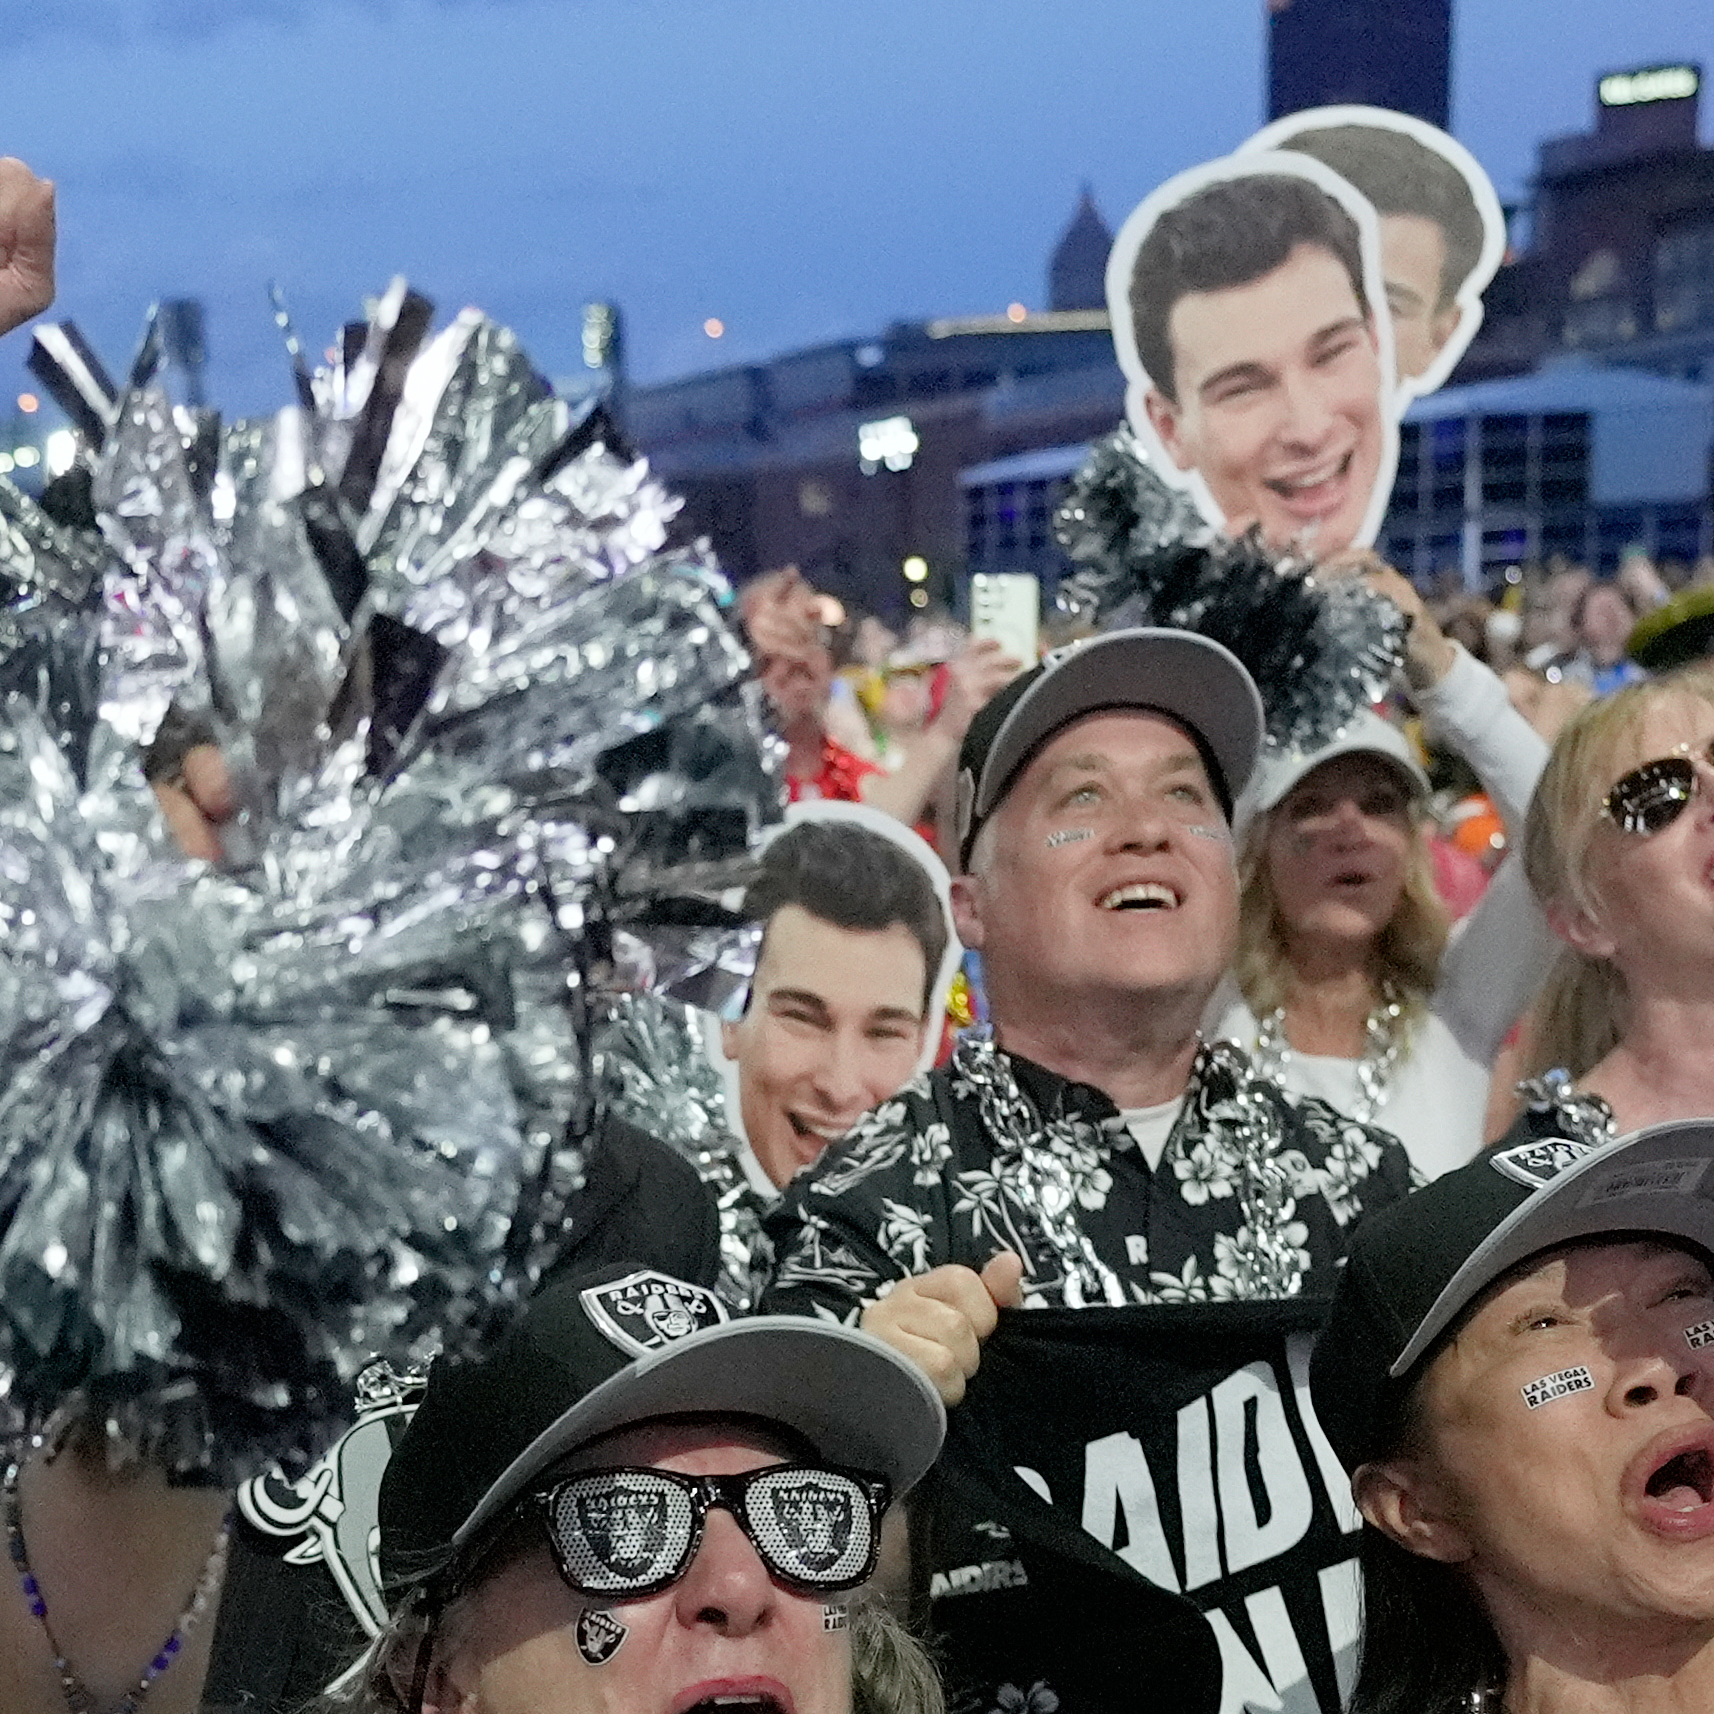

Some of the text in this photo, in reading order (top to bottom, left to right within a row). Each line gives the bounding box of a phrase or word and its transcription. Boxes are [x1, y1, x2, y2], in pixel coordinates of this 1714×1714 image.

[608, 1283, 704, 1302] RAIDERS
[1684, 1322, 1711, 1338] LAS
[1522, 1367, 1588, 1396] LAS VEGAS
[1527, 1376, 1592, 1407] RAIDERS
